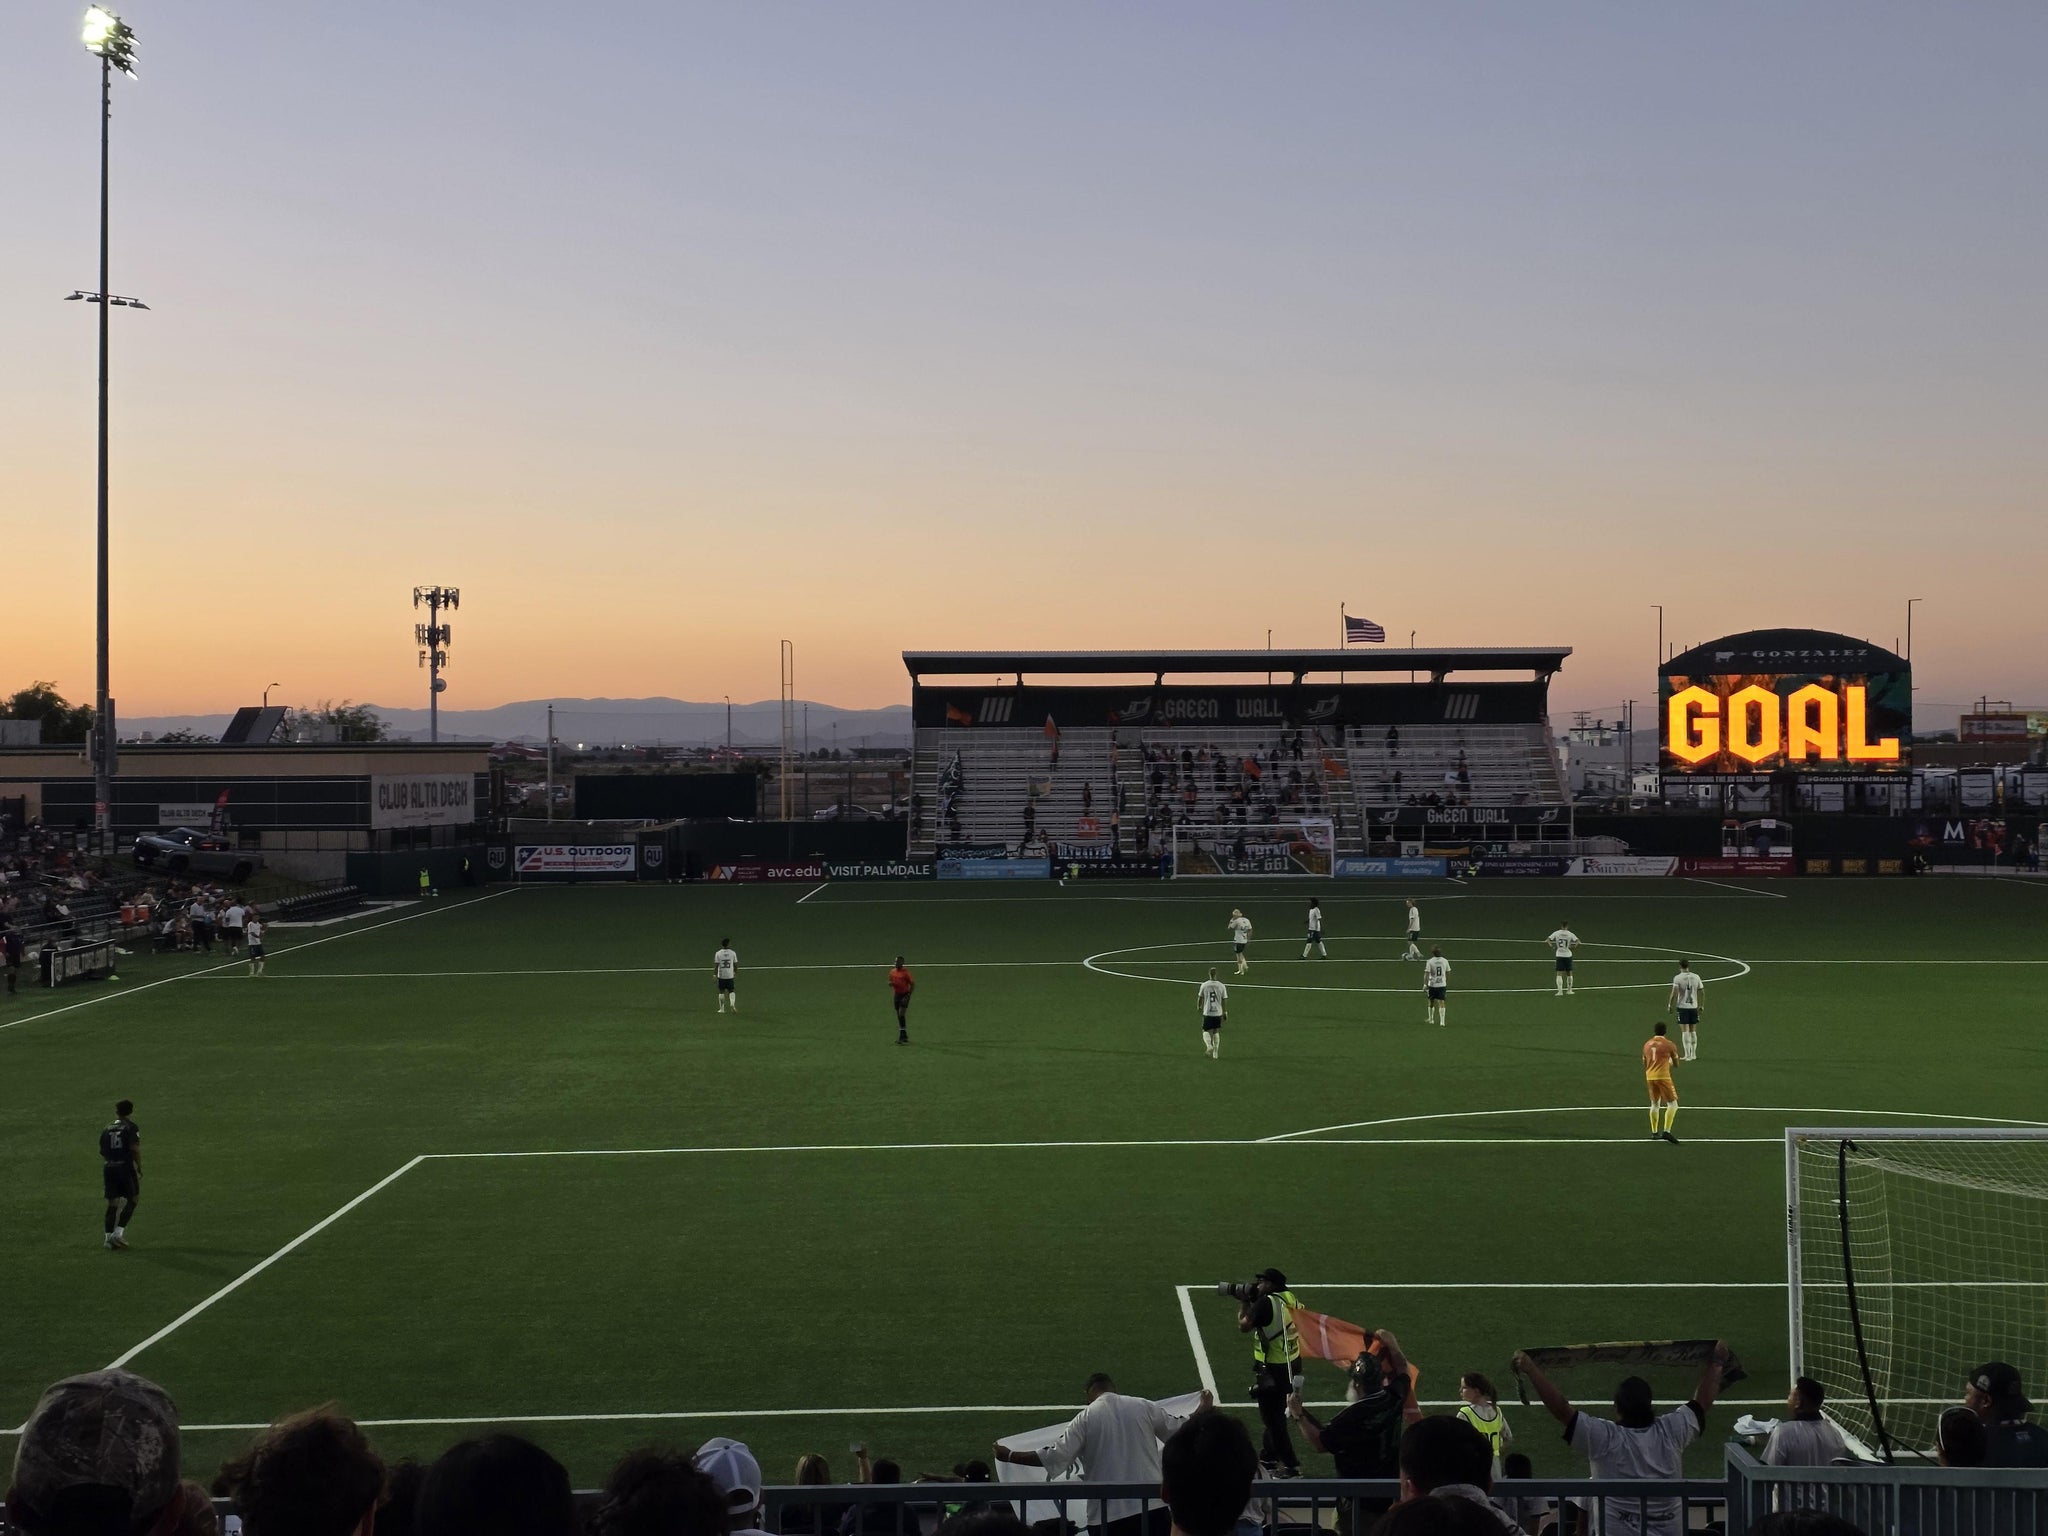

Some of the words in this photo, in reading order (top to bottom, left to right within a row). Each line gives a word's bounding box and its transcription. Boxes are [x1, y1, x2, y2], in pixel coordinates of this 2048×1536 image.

[1751, 648, 1868, 658] GONZALEZ
[1165, 698, 1219, 719] GREEN
[1236, 697, 1284, 717] WALL
[1668, 683, 1900, 764] GOAL
[379, 783, 408, 810] CLUB
[411, 782, 438, 808] ALTA
[440, 781, 468, 807] DECK
[160, 809, 175, 817] CLUB
[176, 809, 190, 817] ALTA
[191, 809, 207, 817] DECK
[1427, 807, 1468, 823] GREEN
[1473, 806, 1509, 823] WALL
[1944, 820, 1965, 840] M
[544, 847, 566, 856] U.S.
[568, 847, 631, 856] OUTDOOR
[767, 866, 821, 877] avc.edu
[829, 866, 861, 877] VISIT
[863, 864, 930, 876] PALMDALE
[1227, 858, 1260, 872] THE
[1264, 857, 1289, 872] 661
[1436, 966, 1442, 976] 8
[1651, 1047, 1657, 1061] 1
